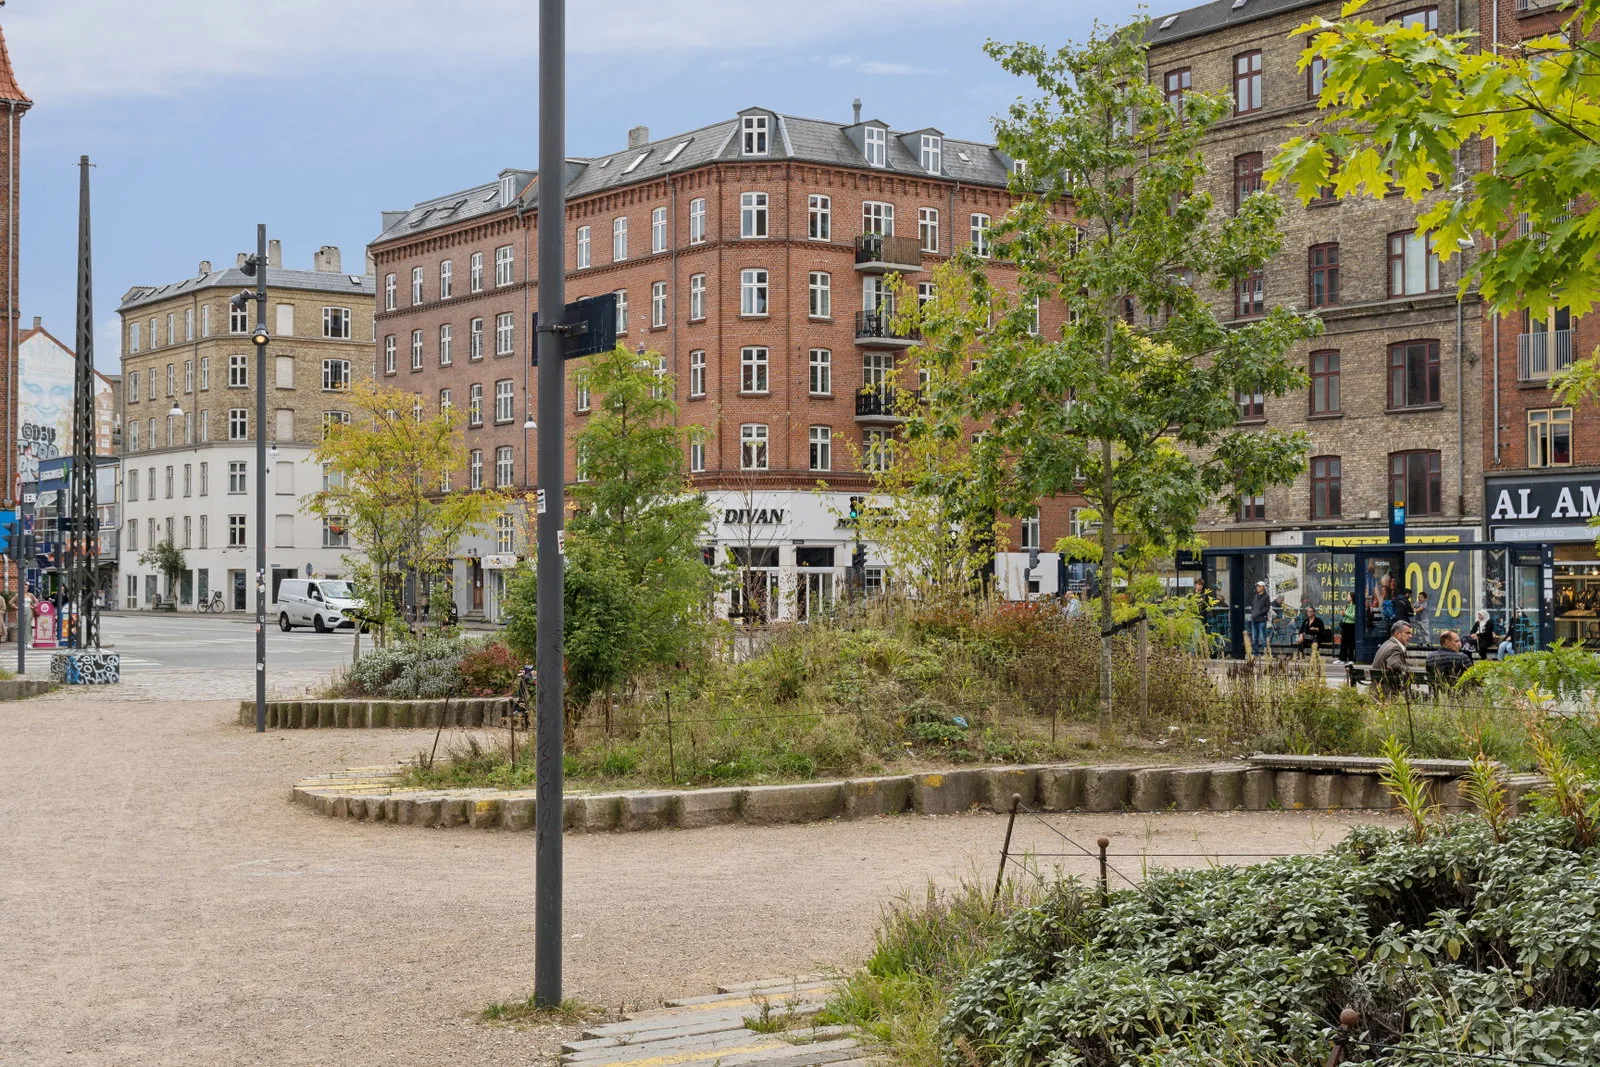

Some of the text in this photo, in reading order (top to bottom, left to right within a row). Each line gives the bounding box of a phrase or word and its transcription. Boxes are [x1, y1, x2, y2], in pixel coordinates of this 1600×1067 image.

[1491, 488, 1540, 519] AL
[723, 508, 784, 524] DIVAN
[1316, 563, 1355, 573] SPAR -70
[1321, 575, 1355, 587] PÅ ALLE
